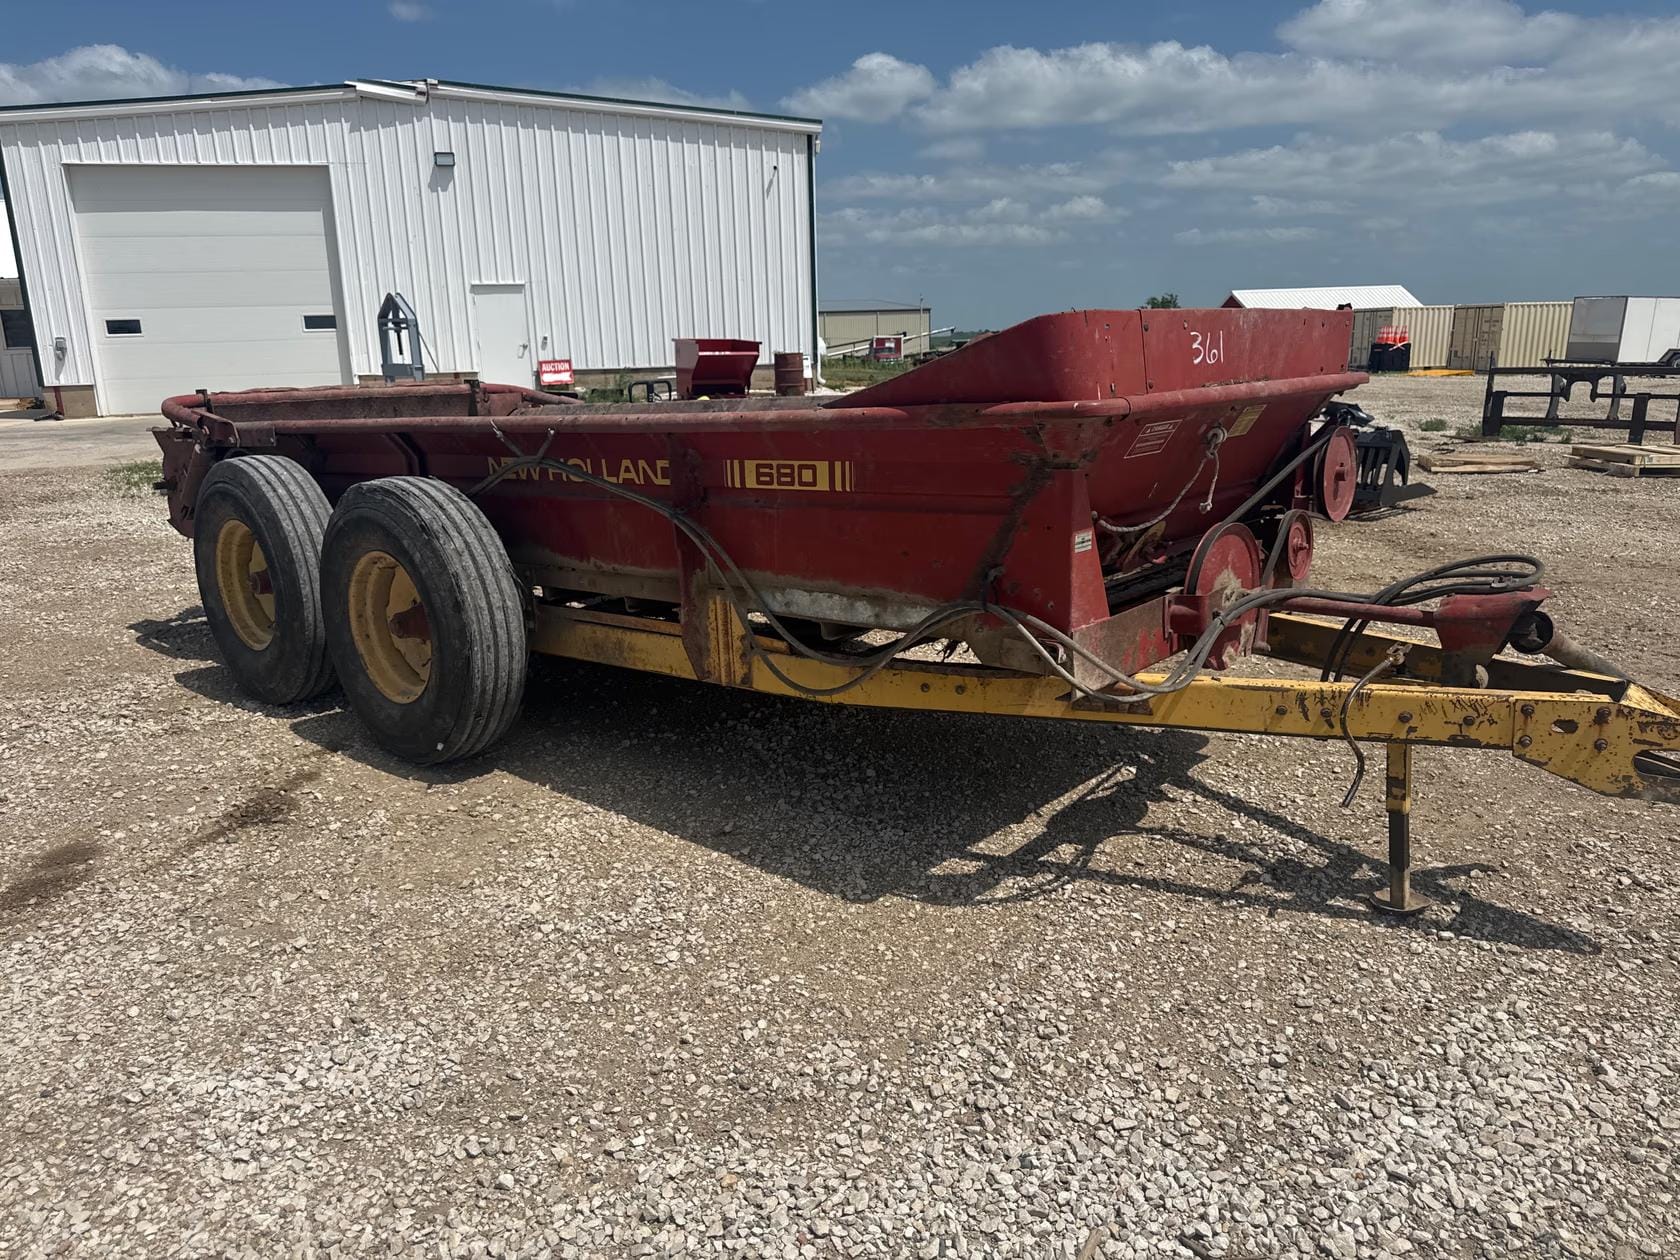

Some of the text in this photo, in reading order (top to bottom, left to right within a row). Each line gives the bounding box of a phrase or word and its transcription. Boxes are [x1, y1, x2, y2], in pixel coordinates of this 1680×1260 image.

[1190, 330, 1224, 365] 361
[541, 361, 570, 372] AUCTION
[755, 463, 818, 487] 680
